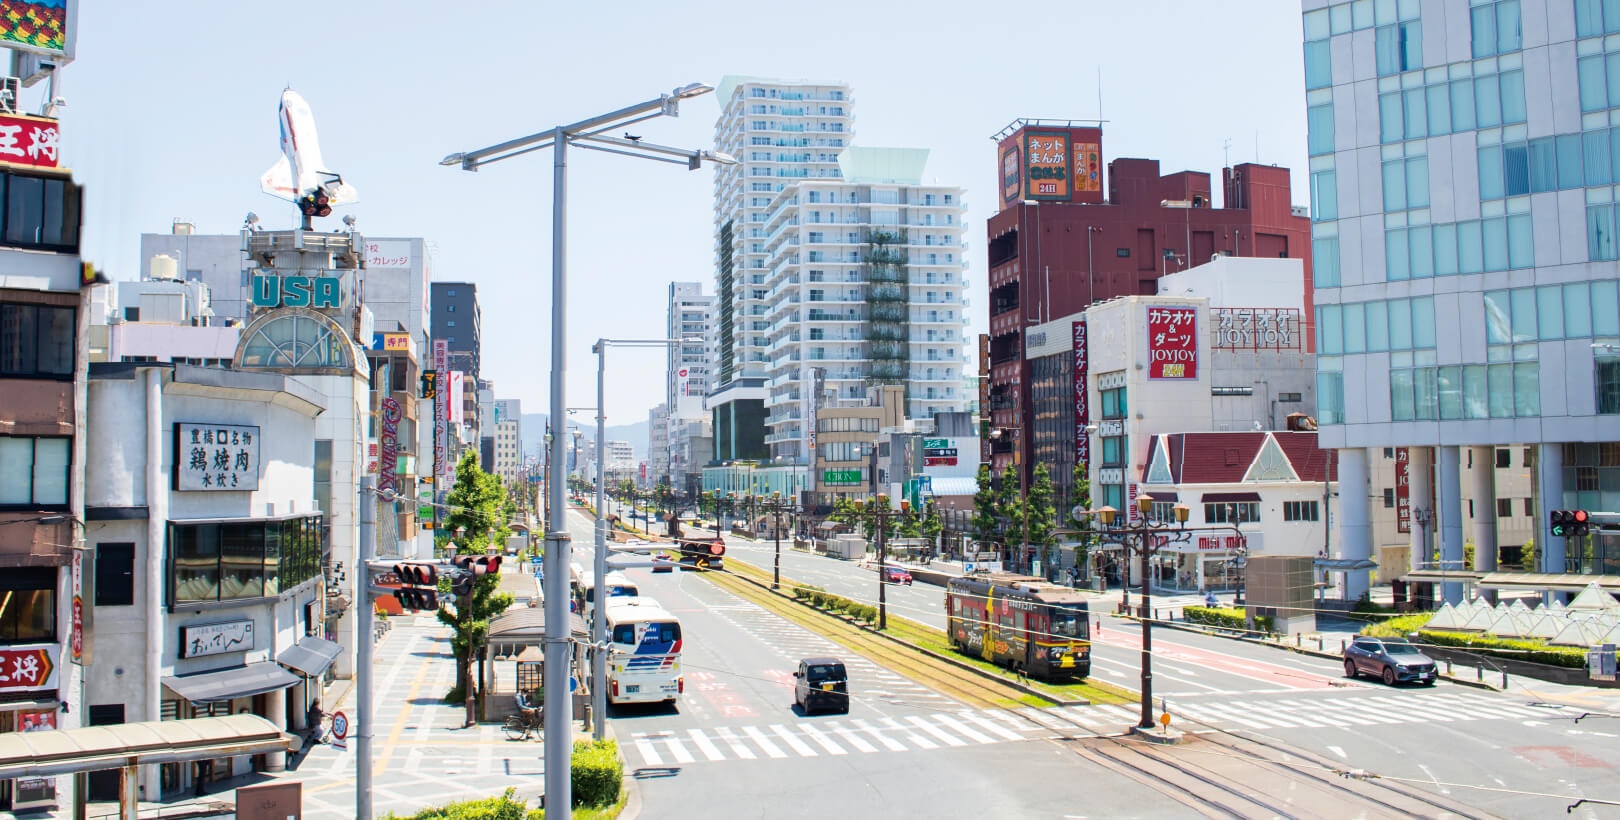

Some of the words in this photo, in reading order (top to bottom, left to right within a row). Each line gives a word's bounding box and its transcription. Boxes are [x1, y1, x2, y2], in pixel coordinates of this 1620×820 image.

[0, 125, 59, 161] 王将
[1030, 139, 1063, 151] ネット
[1031, 153, 1064, 164] まんが
[1040, 184, 1056, 193] 24H
[253, 275, 340, 308] USA
[1150, 310, 1195, 325] カラオケ
[1219, 310, 1289, 328] カラオケ
[1169, 324, 1176, 334] &
[1075, 325, 1086, 369] カラオケ
[1154, 333, 1191, 347] ダーツ
[1150, 349, 1196, 363] JOYJOY
[1164, 364, 1184, 377] 24H
[190, 447, 249, 471] 鶏焼肉
[202, 472, 239, 487] 水炊き
[335, 719, 346, 733] 50
